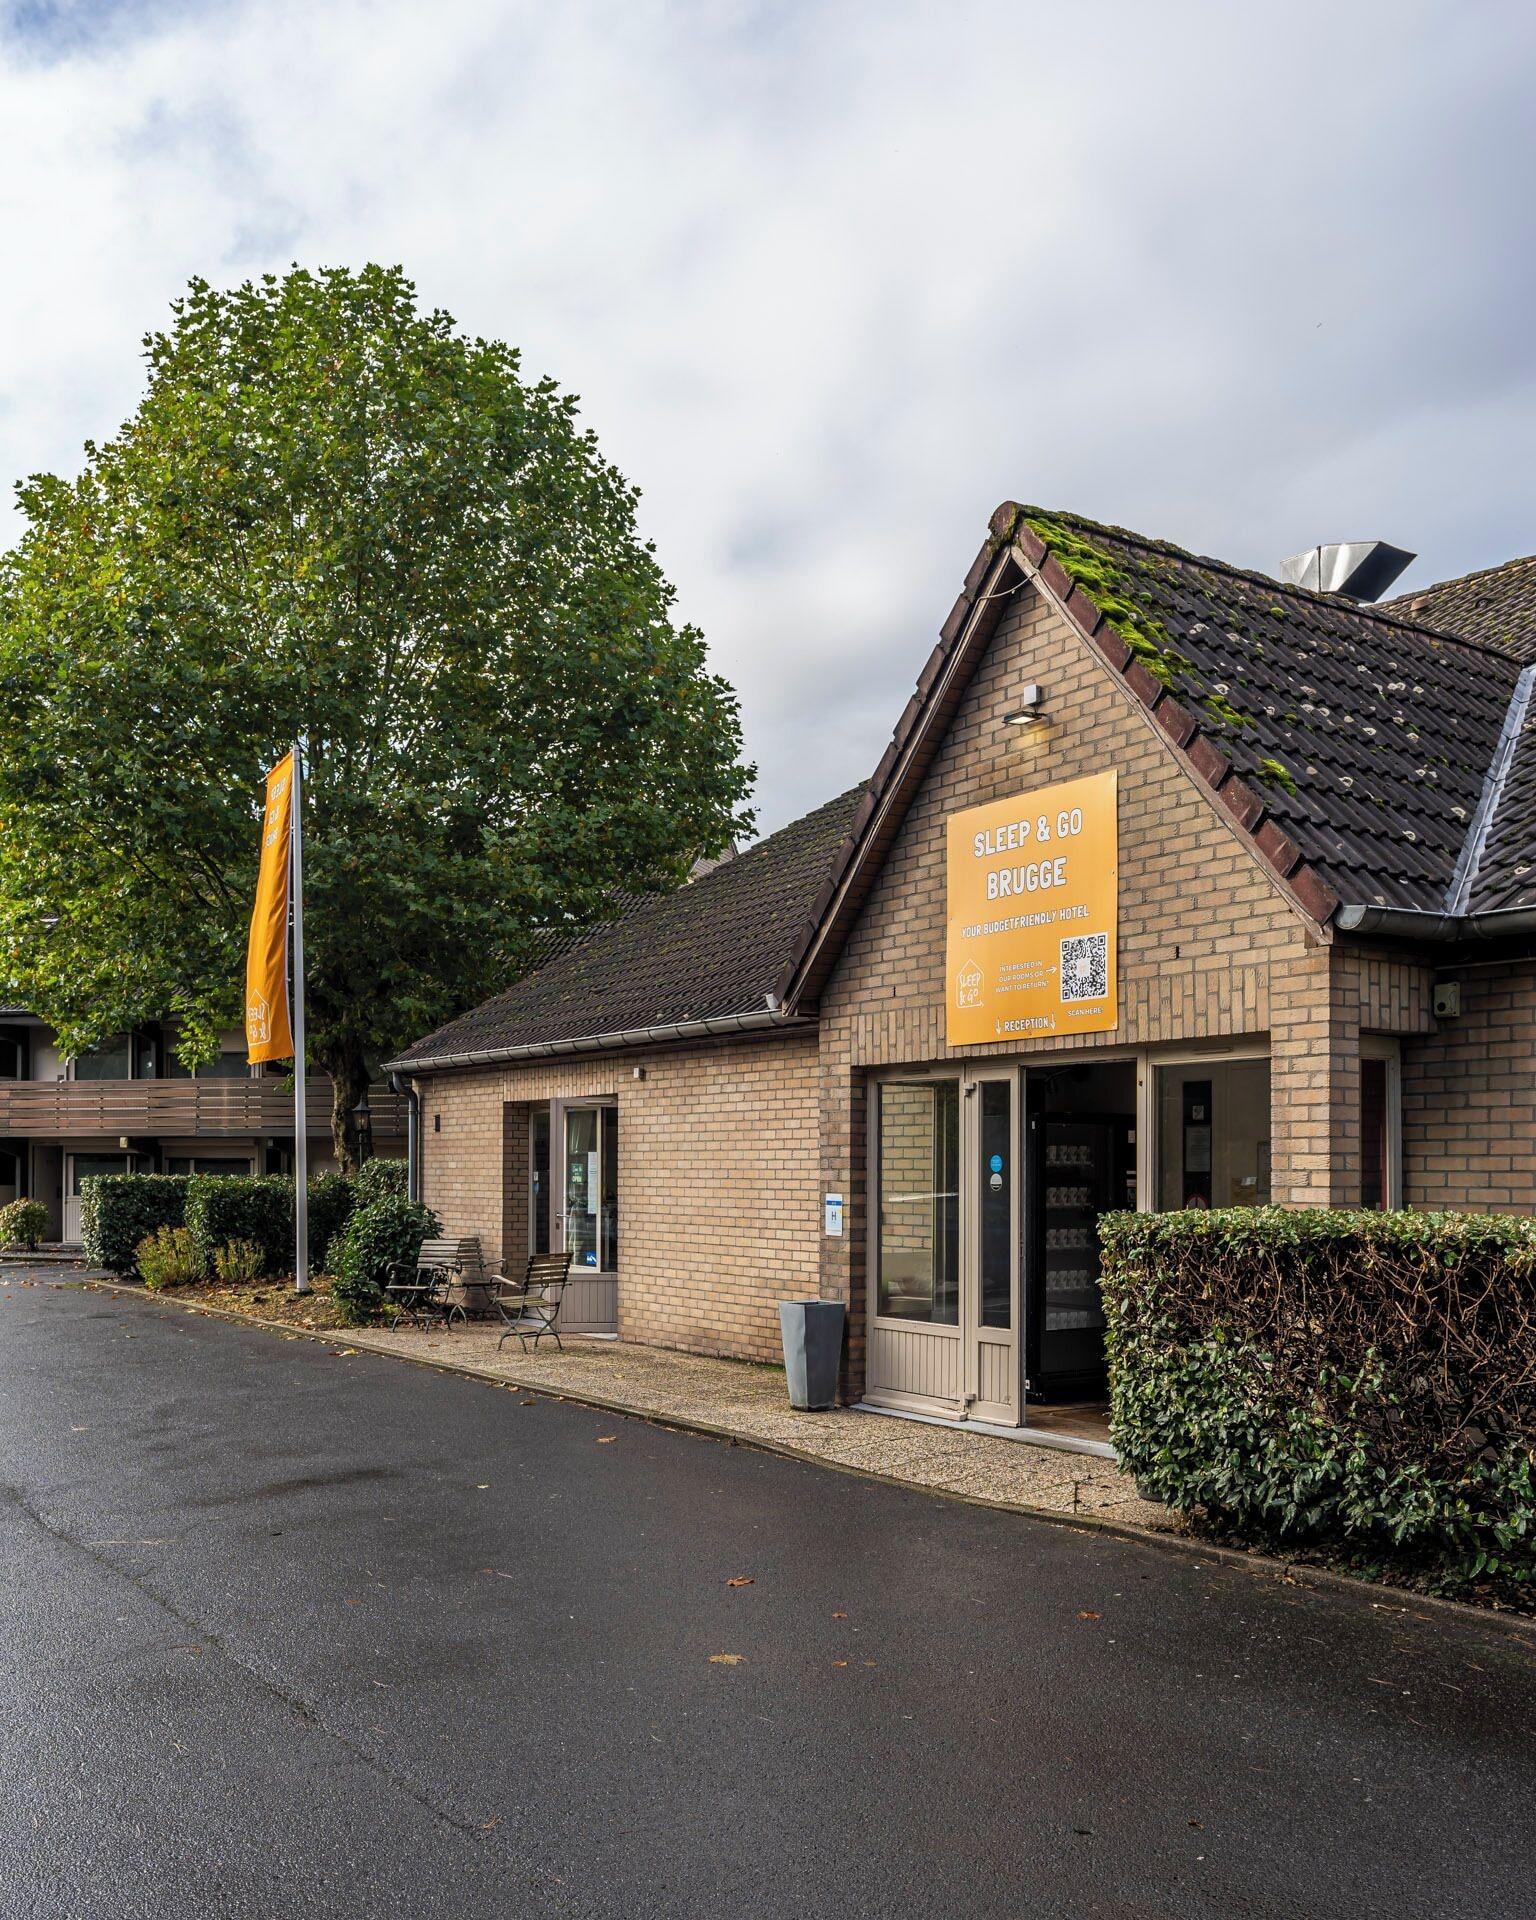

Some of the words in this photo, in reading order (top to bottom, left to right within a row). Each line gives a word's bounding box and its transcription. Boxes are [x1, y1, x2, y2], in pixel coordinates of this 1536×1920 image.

[974, 820, 1031, 858] SLEEP
[1036, 815, 1051, 842] &
[1056, 807, 1082, 838] GO
[987, 856, 1067, 900] BRUGGE
[961, 925, 981, 938] YOUR
[983, 910, 1057, 934] BUDGETFRIENDLY
[1060, 904, 1090, 920] HOTEL
[960, 972, 981, 990] SLEEP
[1004, 1016, 1048, 1032] RECEPTION
[832, 1211, 836, 1220] H
